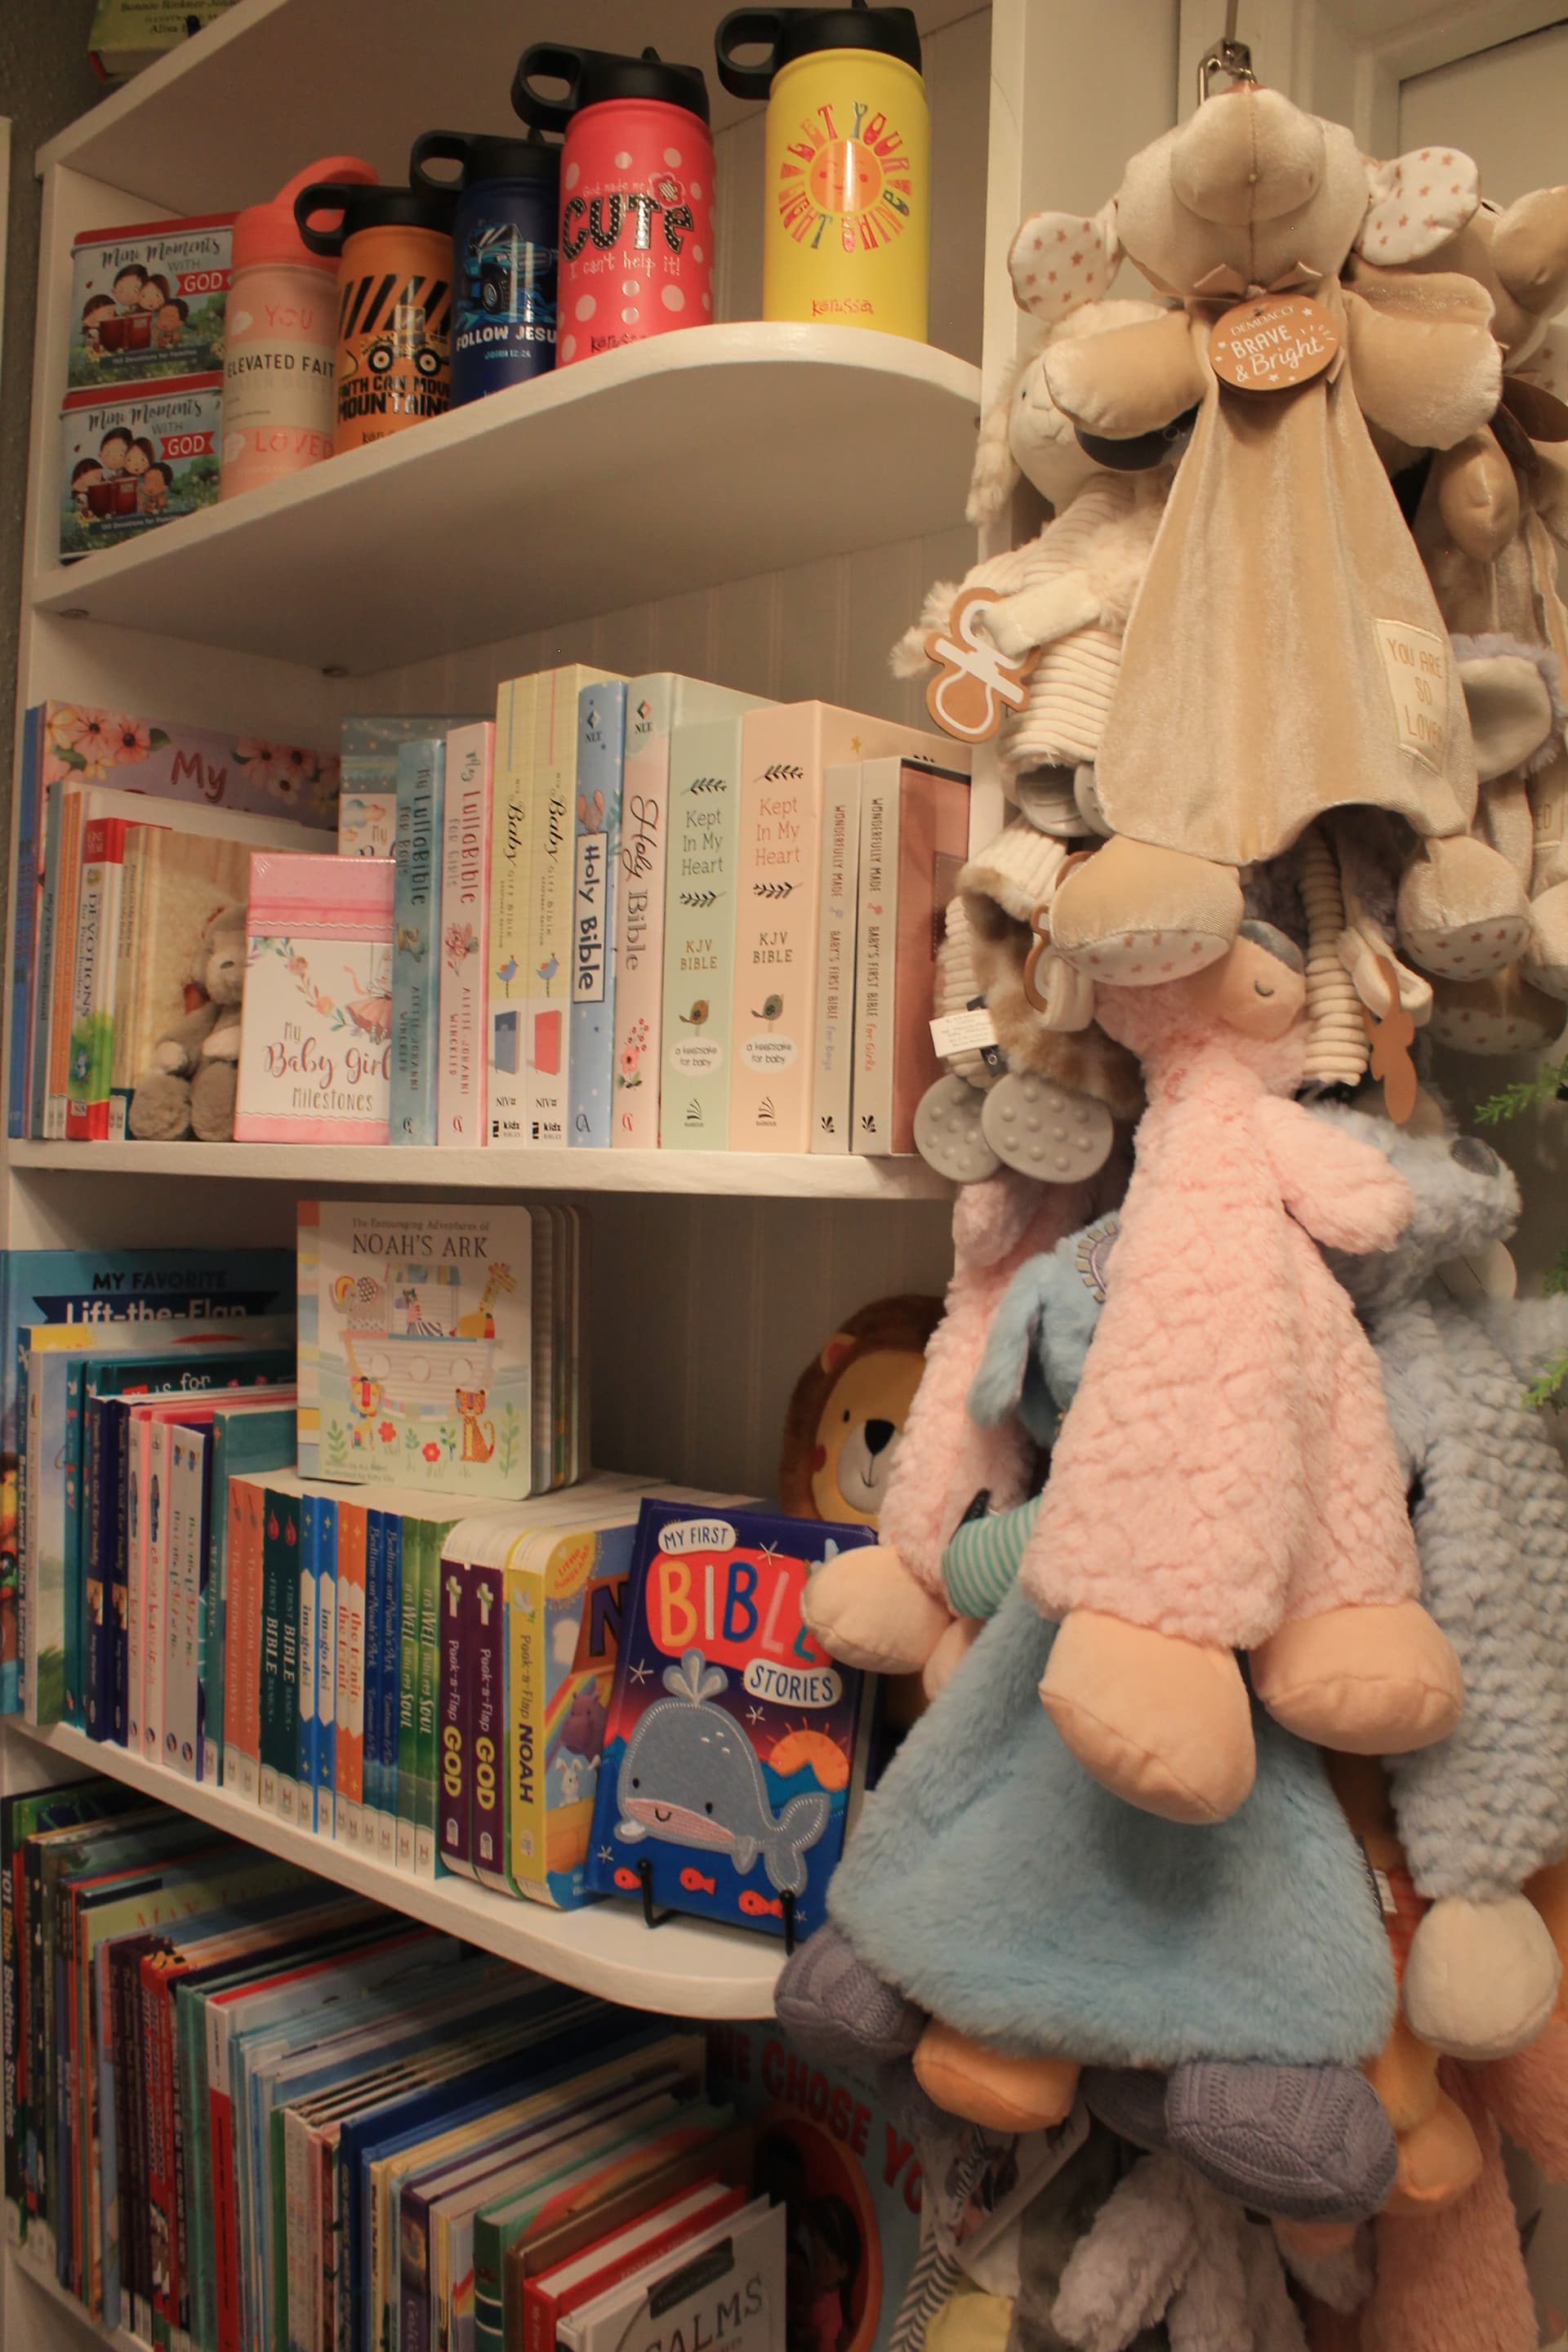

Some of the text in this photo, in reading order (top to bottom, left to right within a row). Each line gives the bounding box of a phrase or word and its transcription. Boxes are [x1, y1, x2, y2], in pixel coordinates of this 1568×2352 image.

[787, 101, 910, 175] LET YOUR
[101, 238, 220, 269] Mini Moments
[167, 260, 201, 272] WITH
[582, 252, 614, 274] can't
[623, 250, 657, 278] help
[663, 255, 680, 276] it!
[184, 272, 222, 292] GOD
[265, 305, 314, 331] YOU
[456, 323, 556, 352] FOLLOW JESU
[1230, 324, 1292, 359] BRAVE
[227, 353, 336, 378] ELEVATED FAIT
[1235, 336, 1325, 382] & Bright
[372, 376, 406, 391] CAN
[89, 399, 203, 432] Mini Moments
[152, 422, 184, 435] WITH
[167, 434, 204, 456] GOD
[255, 430, 335, 460] LOVED
[1386, 637, 1443, 679] YOU ARE
[1414, 676, 1432, 706] SO
[1405, 705, 1442, 750] LOVE
[171, 750, 228, 804] My
[686, 808, 722, 830] Kept
[760, 796, 798, 819] Kept
[502, 799, 526, 867] Baby
[544, 795, 568, 863] Baby
[682, 832, 724, 853] In My
[756, 820, 800, 841] In My
[832, 804, 847, 869] WONDERFULLY
[681, 857, 724, 876] Heart
[755, 847, 800, 866] Heart
[621, 794, 660, 972] Holy Bible
[831, 873, 844, 898] MADE
[577, 844, 603, 991] Holy Bible
[685, 939, 713, 953] KJV
[759, 931, 788, 946] KJV
[829, 930, 842, 962] BABY'S
[864, 797, 884, 1072] WONDERFULLY MADE BABY'S FIRST BIBLE for Girls
[82, 893, 98, 1017] DEVOTIONS
[679, 956, 718, 971] BIBLE
[752, 948, 793, 964] BIBLE
[828, 966, 841, 991] FIRST
[826, 996, 840, 1020] BIBLE
[284, 1022, 301, 1045] My
[261, 1036, 333, 1089] Baby
[352, 1217, 367, 1228] The
[352, 1233, 488, 1258] NOAH'S ARK
[92, 1270, 229, 1290] MY FAVORITE
[179, 1372, 212, 1393] for
[368, 1526, 379, 1578] Bedtime
[664, 1526, 728, 1550] MY FIRST
[385, 1529, 397, 1580] Bedtime
[337, 1604, 350, 1634] the
[350, 1611, 361, 1641] the
[401, 1605, 417, 1642] WELL
[420, 1610, 438, 1649] WELL
[265, 1616, 278, 1676] BIBLE
[282, 1624, 296, 1683] BIBLE
[300, 1605, 312, 1687] imago dei
[318, 1608, 332, 1691] imago dei
[751, 1664, 834, 1703] STORIES
[418, 1699, 434, 1735] SOUL
[443, 1724, 462, 1797] GOD
[475, 1735, 496, 1811] GOD
[519, 1723, 533, 1804] NOAH
[2, 1868, 16, 2136] 101 Bible Bedtime Stories
[761, 2038, 923, 2216] CHOSE YO
